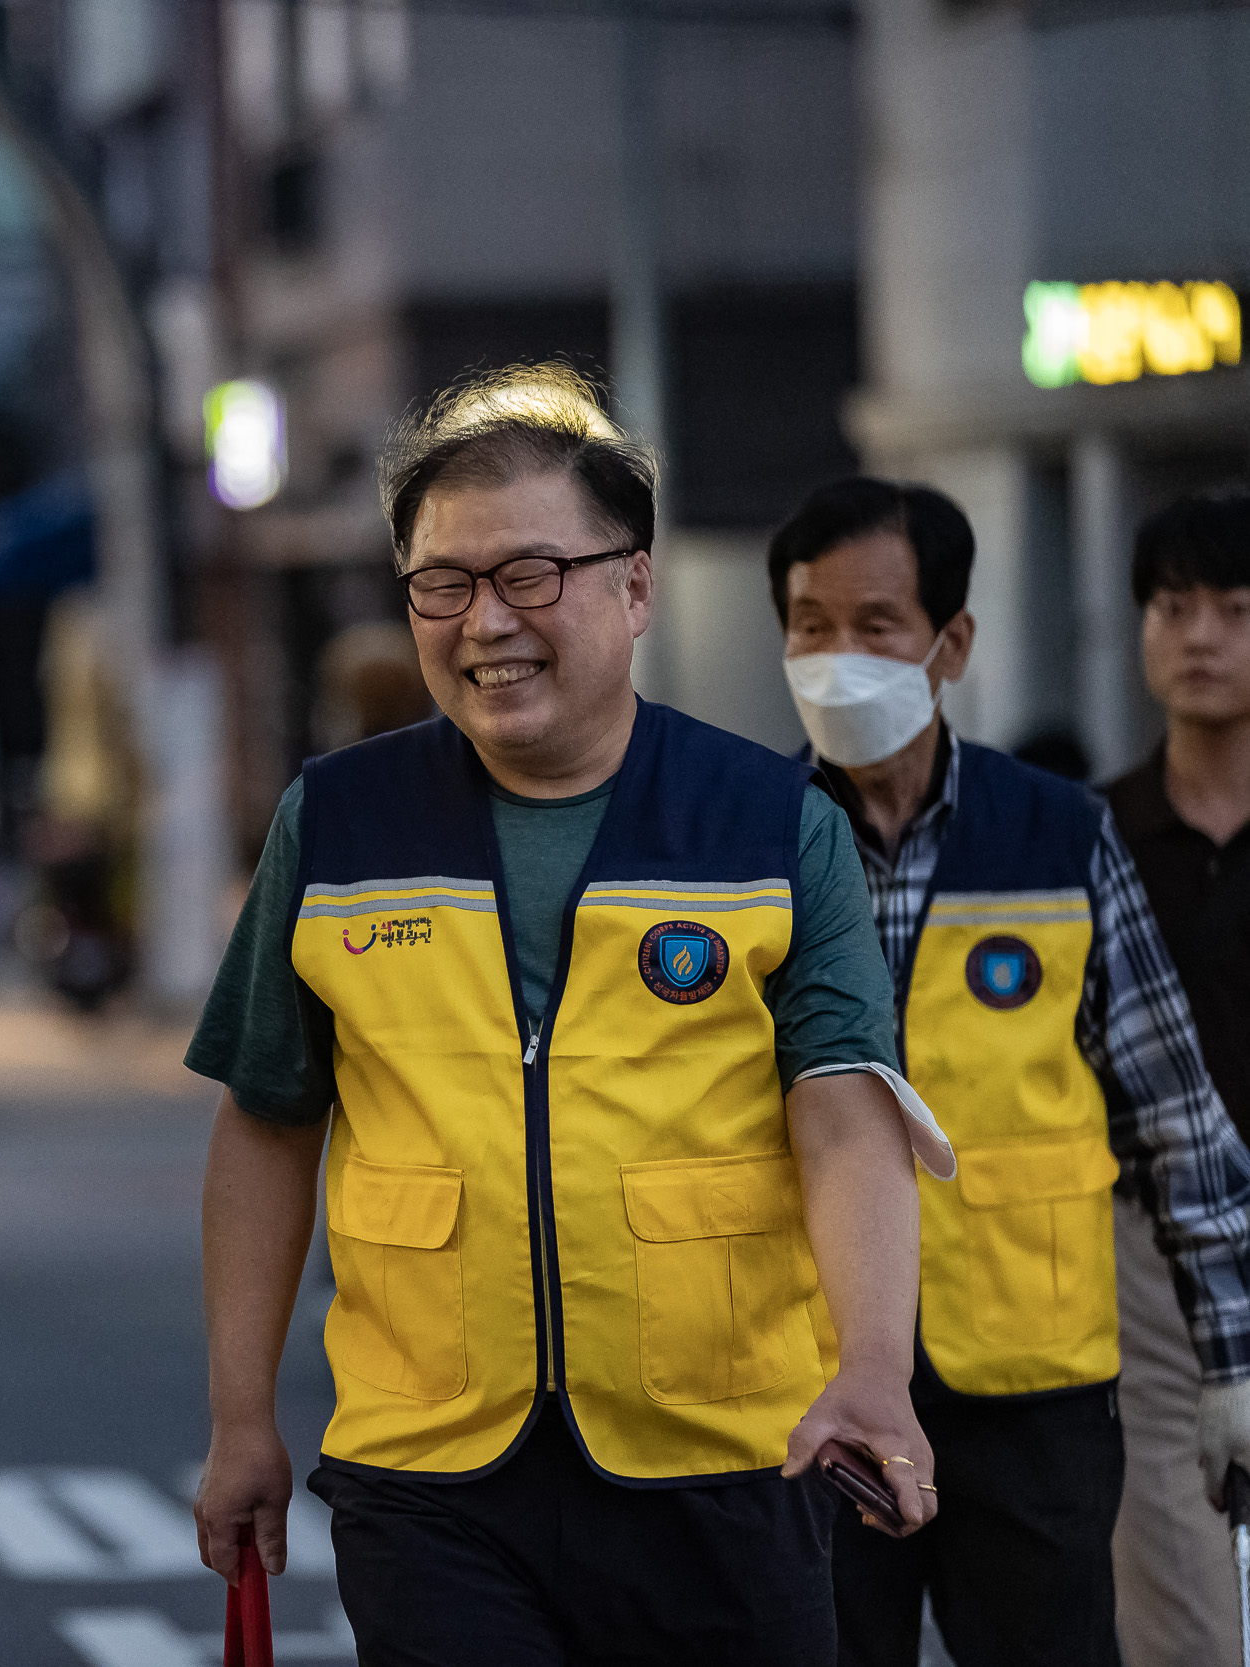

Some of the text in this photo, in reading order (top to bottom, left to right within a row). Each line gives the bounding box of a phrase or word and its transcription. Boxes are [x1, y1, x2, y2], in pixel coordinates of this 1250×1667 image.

[380, 927, 432, 949] 행복광진
[643, 941, 653, 975] CITIZEN
[650, 923, 674, 940] CORPS
[676, 922, 706, 934] ACTIVE
[706, 932, 716, 940] IN
[653, 981, 714, 1002] 전국자율방재단
